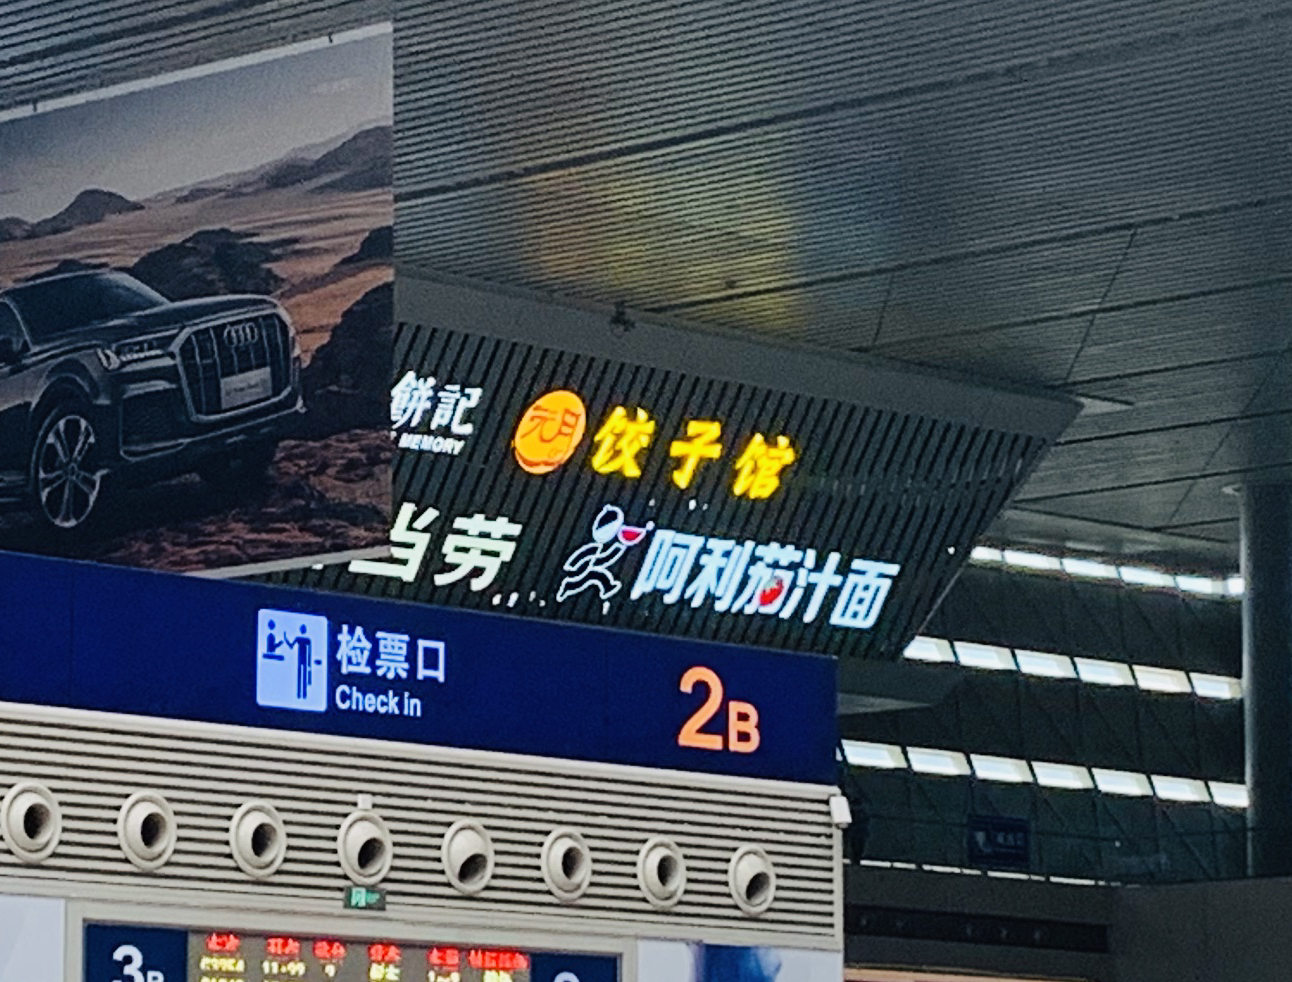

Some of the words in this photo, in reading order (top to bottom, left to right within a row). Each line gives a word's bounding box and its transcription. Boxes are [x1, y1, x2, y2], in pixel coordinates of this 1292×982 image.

[398, 432, 465, 455] MEMORY
[592, 405, 795, 499] 饺子馆
[347, 502, 523, 591] 当劳
[630, 529, 901, 628] 阿利茄汁面
[335, 624, 446, 683] 检票口
[335, 684, 399, 715] Check
[402, 688, 422, 717] in
[678, 666, 760, 753] 2B
